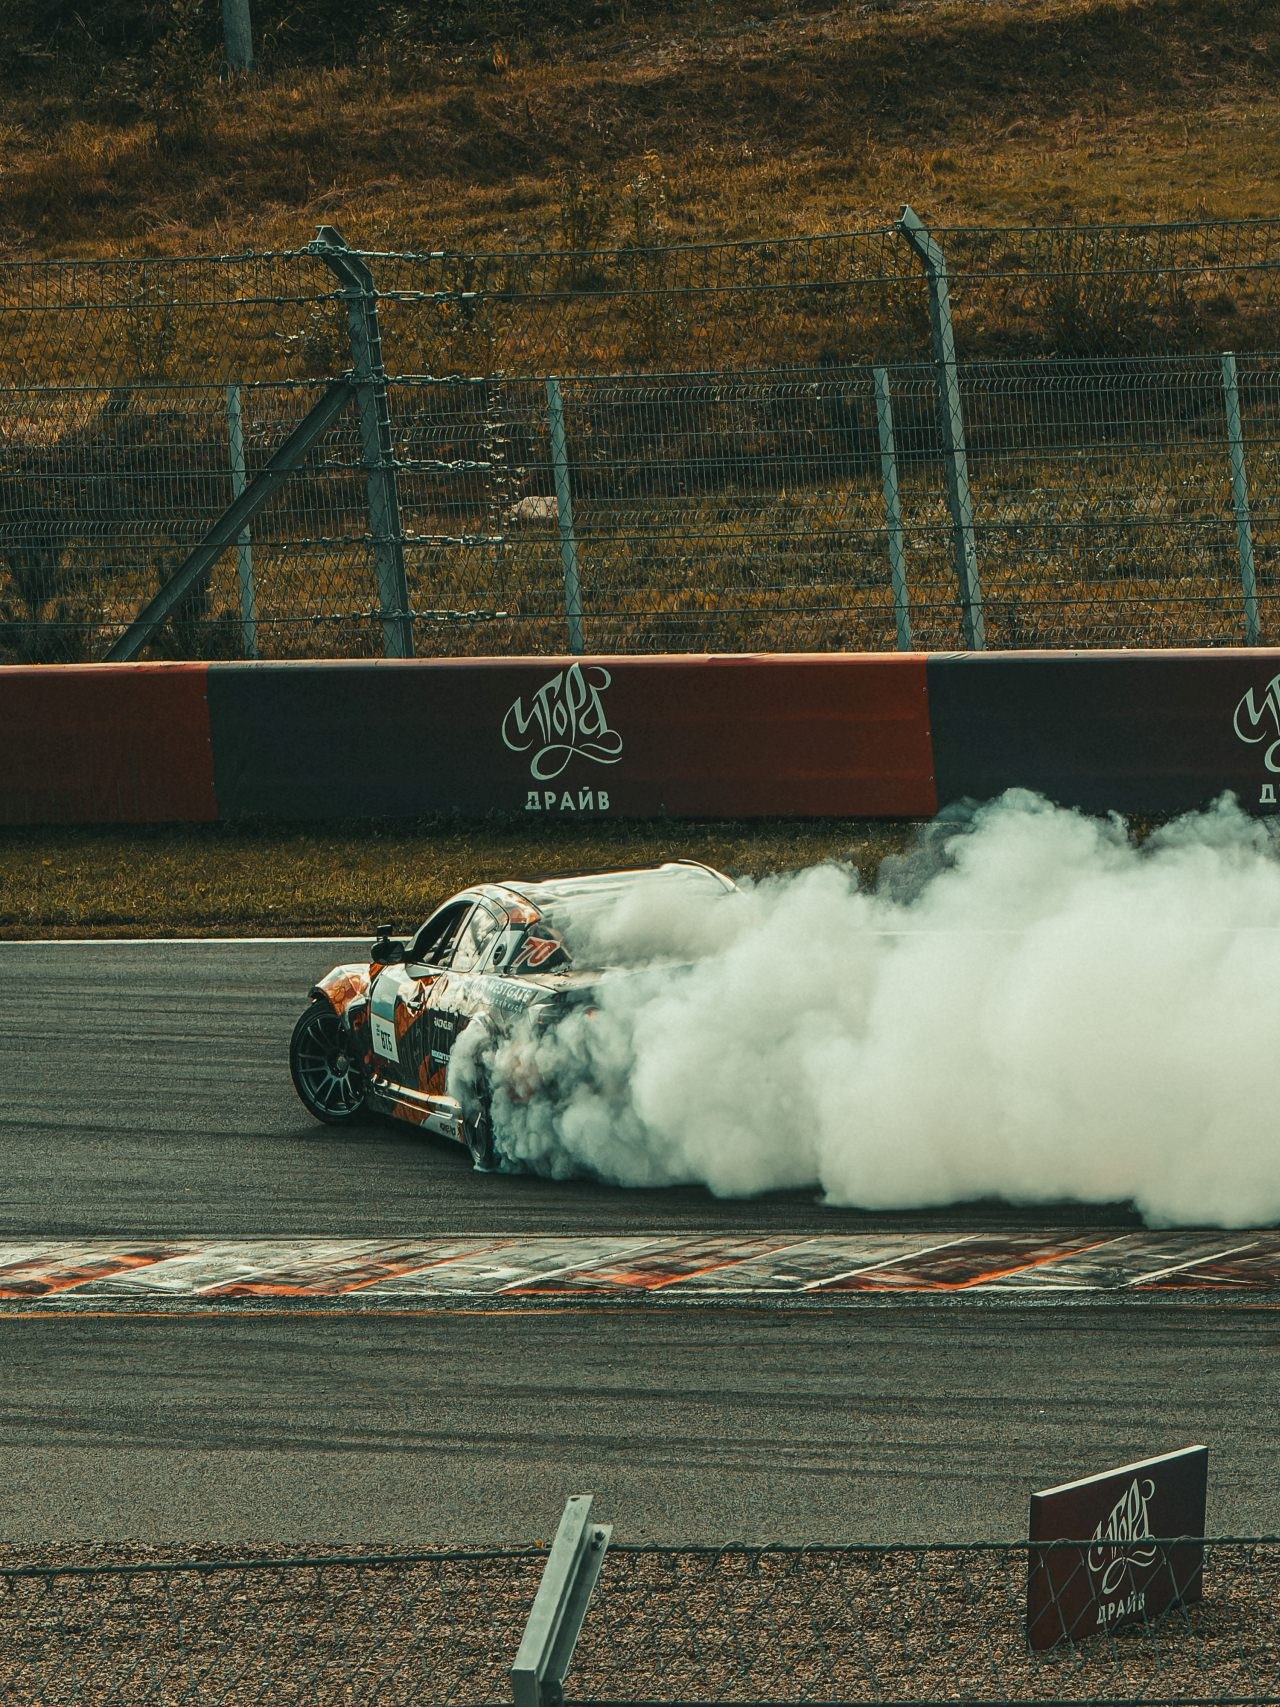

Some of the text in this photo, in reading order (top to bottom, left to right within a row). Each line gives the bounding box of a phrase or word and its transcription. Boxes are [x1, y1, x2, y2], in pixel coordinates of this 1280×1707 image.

[525, 786, 610, 811] ДРАЙВ
[511, 936, 560, 967] 70
[488, 979, 533, 1002] WESTGATE
[1096, 1591, 1145, 1625] ДРАЙВ
